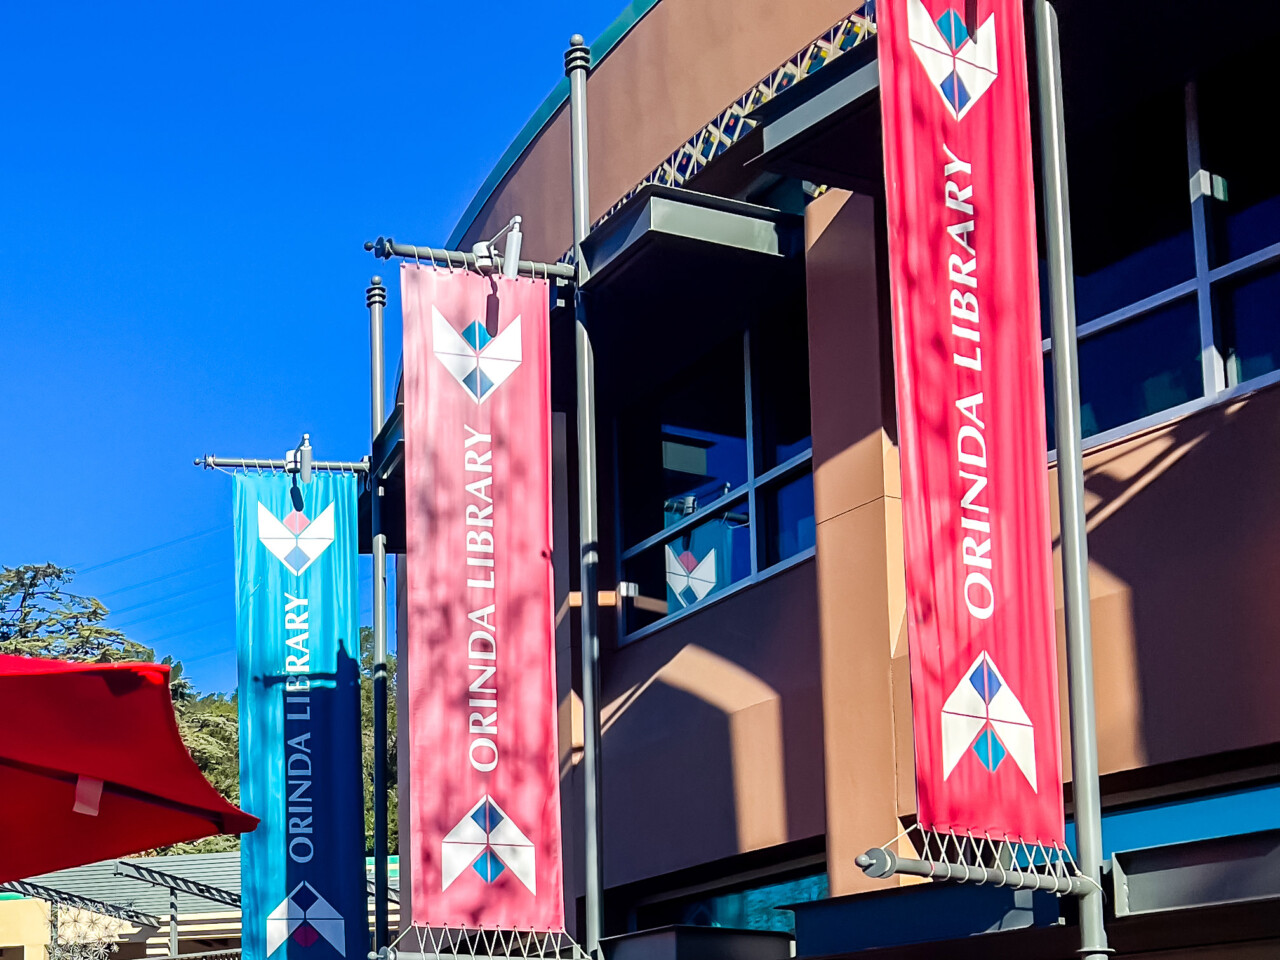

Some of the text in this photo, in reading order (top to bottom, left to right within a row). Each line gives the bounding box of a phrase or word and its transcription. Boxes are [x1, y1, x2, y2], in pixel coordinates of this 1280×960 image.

[942, 143, 995, 622] ORINDA LIBRARY
[284, 591, 315, 864] ORINDA LIBRARY
[462, 423, 499, 773] ORINDA LIBRARY
